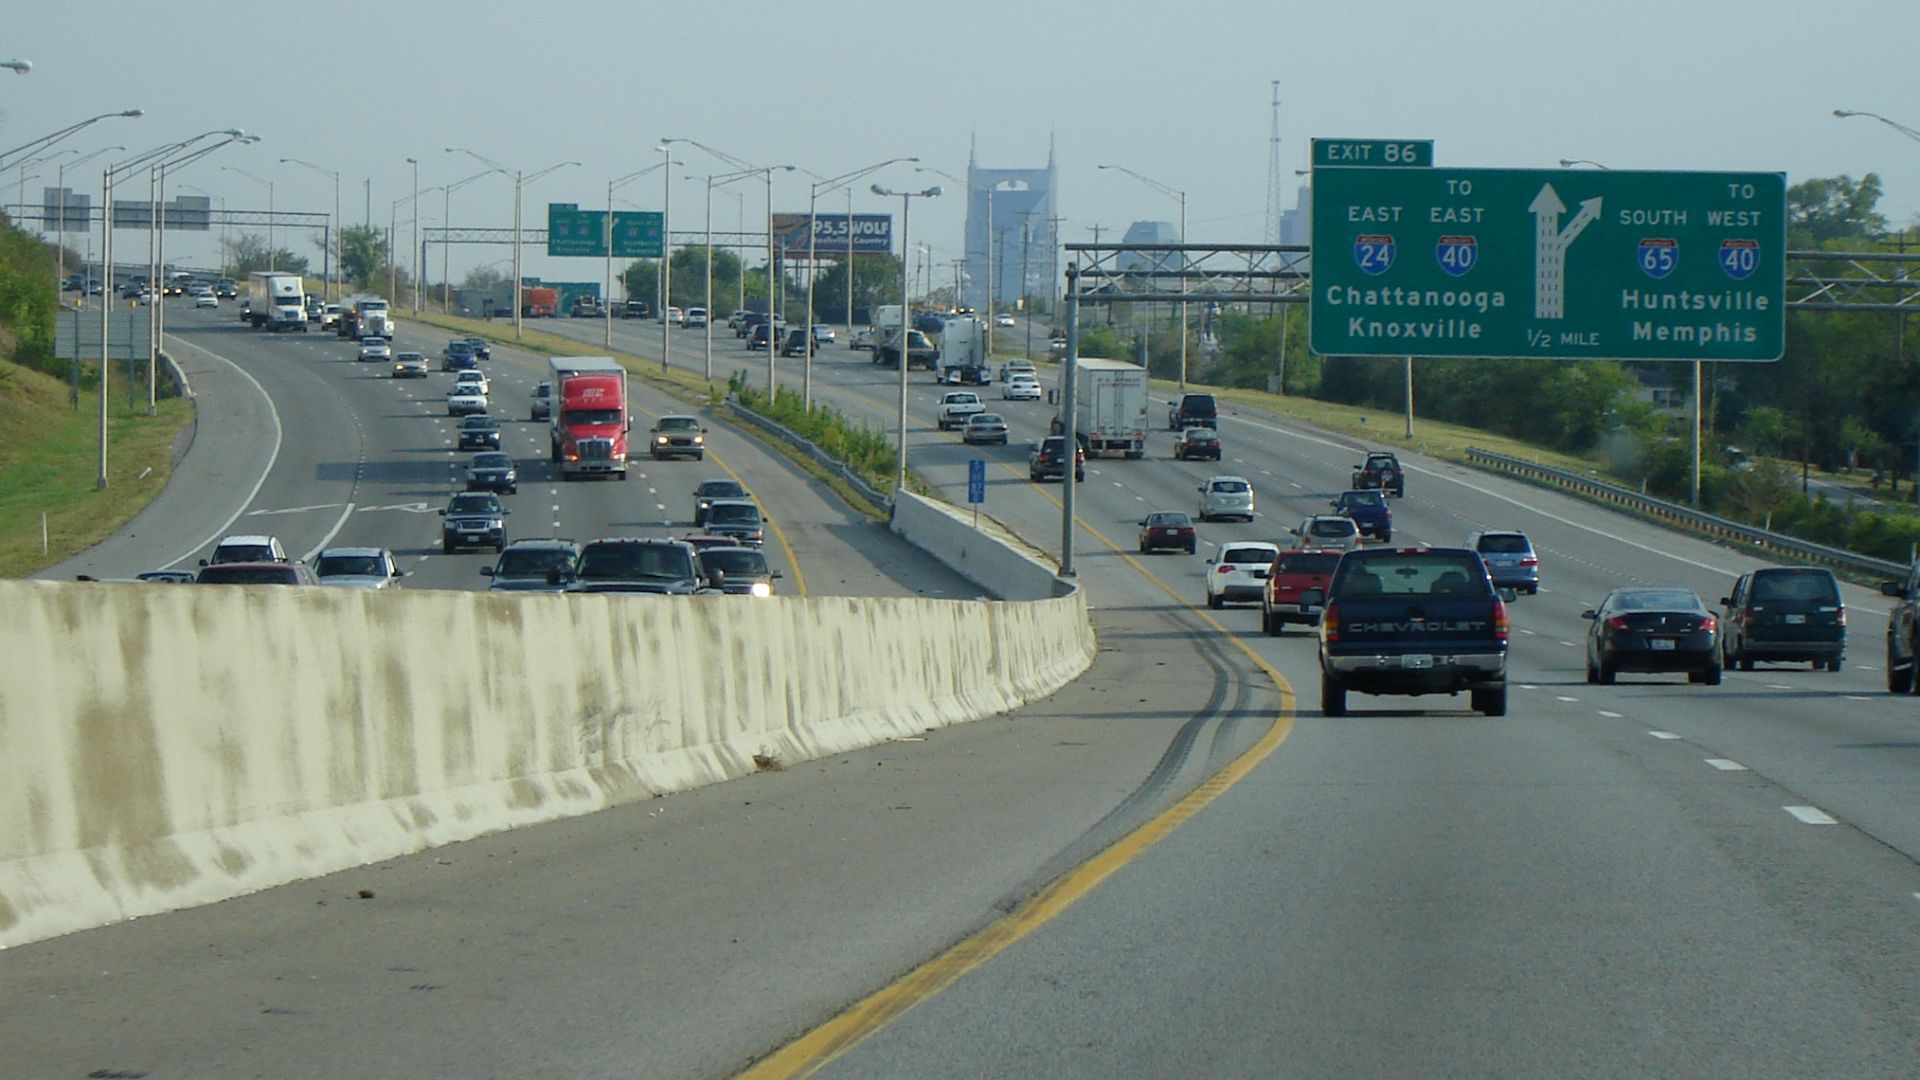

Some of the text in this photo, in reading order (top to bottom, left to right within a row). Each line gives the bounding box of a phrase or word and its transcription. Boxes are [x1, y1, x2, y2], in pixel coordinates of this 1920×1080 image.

[1328, 143, 1417, 163] EXIT 86
[1446, 179, 1473, 195] TO
[1728, 183, 1755, 199] TO
[1348, 206, 1403, 222] EAST
[1430, 207, 1485, 223] EAST
[1619, 209, 1687, 225] SOUTH
[1707, 210, 1762, 226] WEST
[852, 221, 888, 235] WOLF
[1361, 244, 1390, 267] 24
[1442, 245, 1471, 268] 40
[1644, 248, 1673, 271] 65
[1725, 249, 1754, 272] 40
[1327, 284, 1506, 313] Chattanooga
[1622, 289, 1769, 311] Huntsville
[1348, 317, 1482, 339] Knoxville
[1633, 321, 1758, 346] Memphis
[1560, 332, 1600, 346] MILE
[1348, 621, 1486, 633] CHEVROLET
